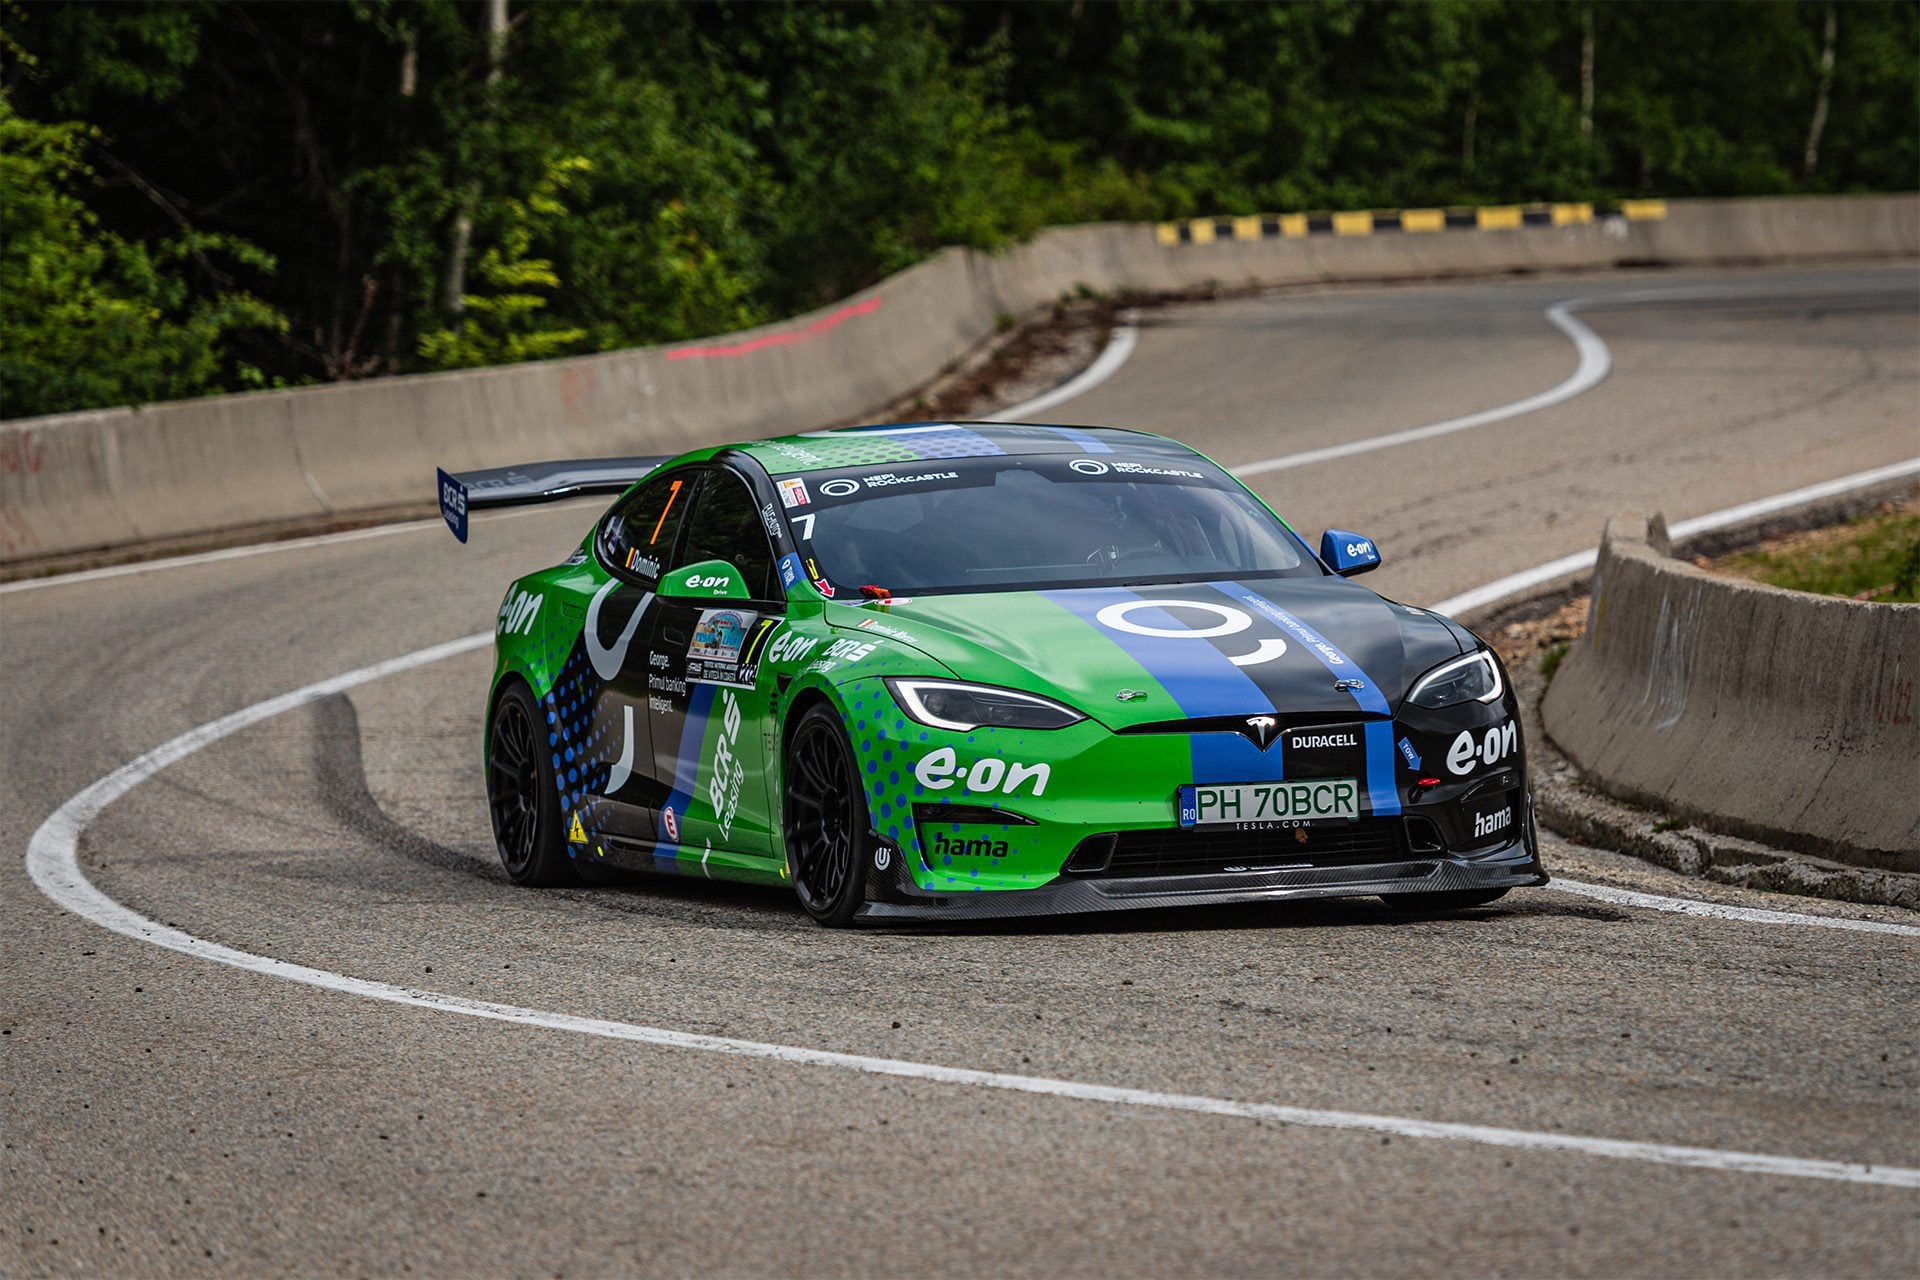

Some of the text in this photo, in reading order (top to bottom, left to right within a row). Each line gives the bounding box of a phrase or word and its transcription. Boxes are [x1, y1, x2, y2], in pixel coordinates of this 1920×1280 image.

[867, 471, 959, 488] ROCKCASTLE
[1116, 467, 1203, 479] ROCKCASTLE
[791, 513, 816, 541] 7
[630, 549, 660, 580] Dominic
[744, 619, 774, 665] 7
[649, 673, 686, 697] Primul banking
[1292, 734, 1357, 749] DURACELL
[1402, 743, 1415, 760] TOW
[718, 758, 745, 842] Leasing
[1197, 783, 1354, 820] PH 70BCR
[1183, 808, 1196, 821] RO
[1236, 820, 1311, 831] TESLA.COM
[1474, 806, 1511, 838] hama
[934, 831, 1009, 857] hama
